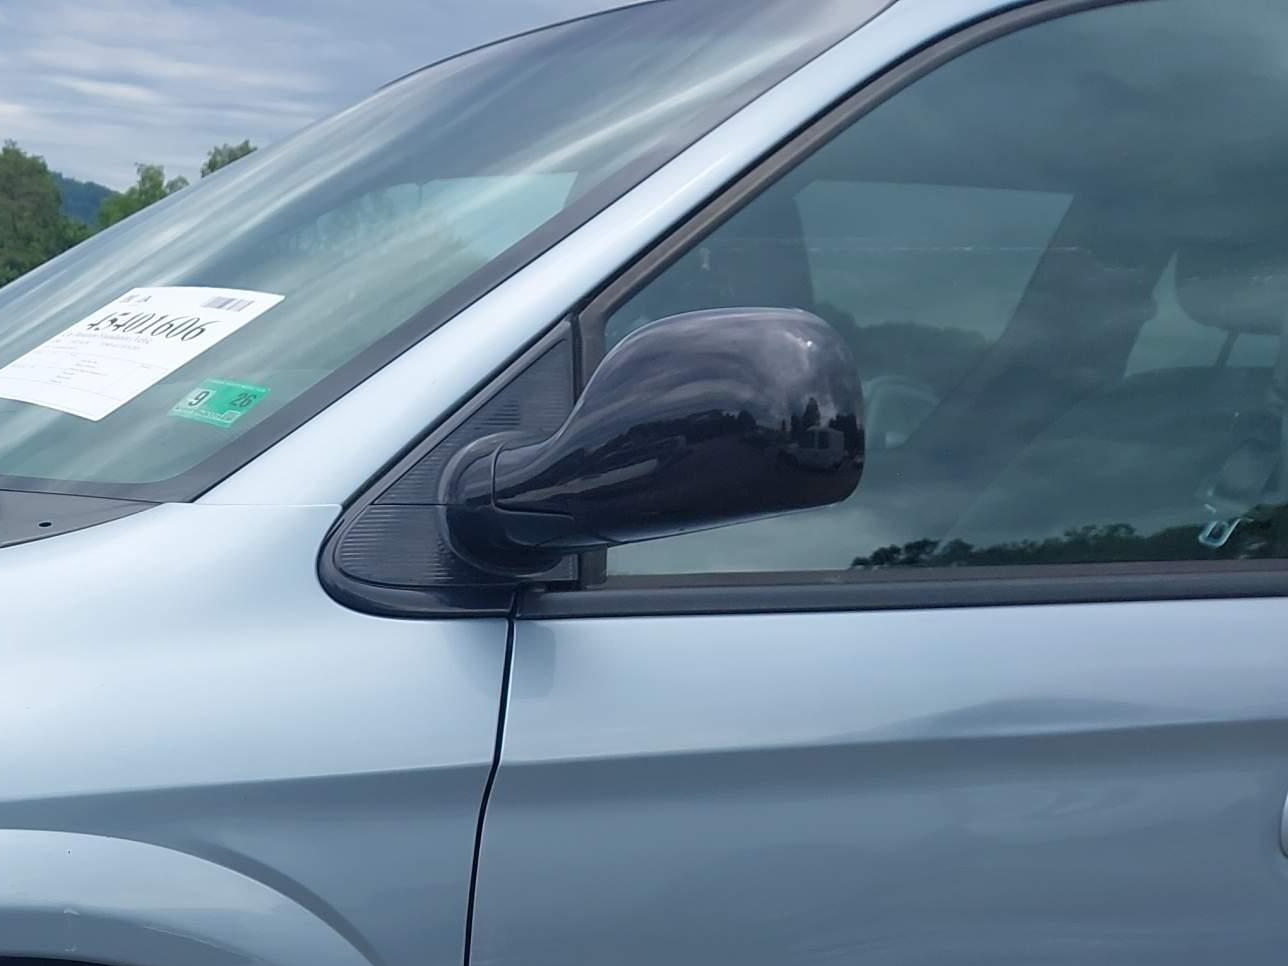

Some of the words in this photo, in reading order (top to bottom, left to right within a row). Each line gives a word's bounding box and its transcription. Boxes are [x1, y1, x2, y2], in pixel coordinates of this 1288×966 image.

[86, 311, 222, 342] 45401606
[187, 390, 210, 407] 9
[229, 392, 257, 408] 26
